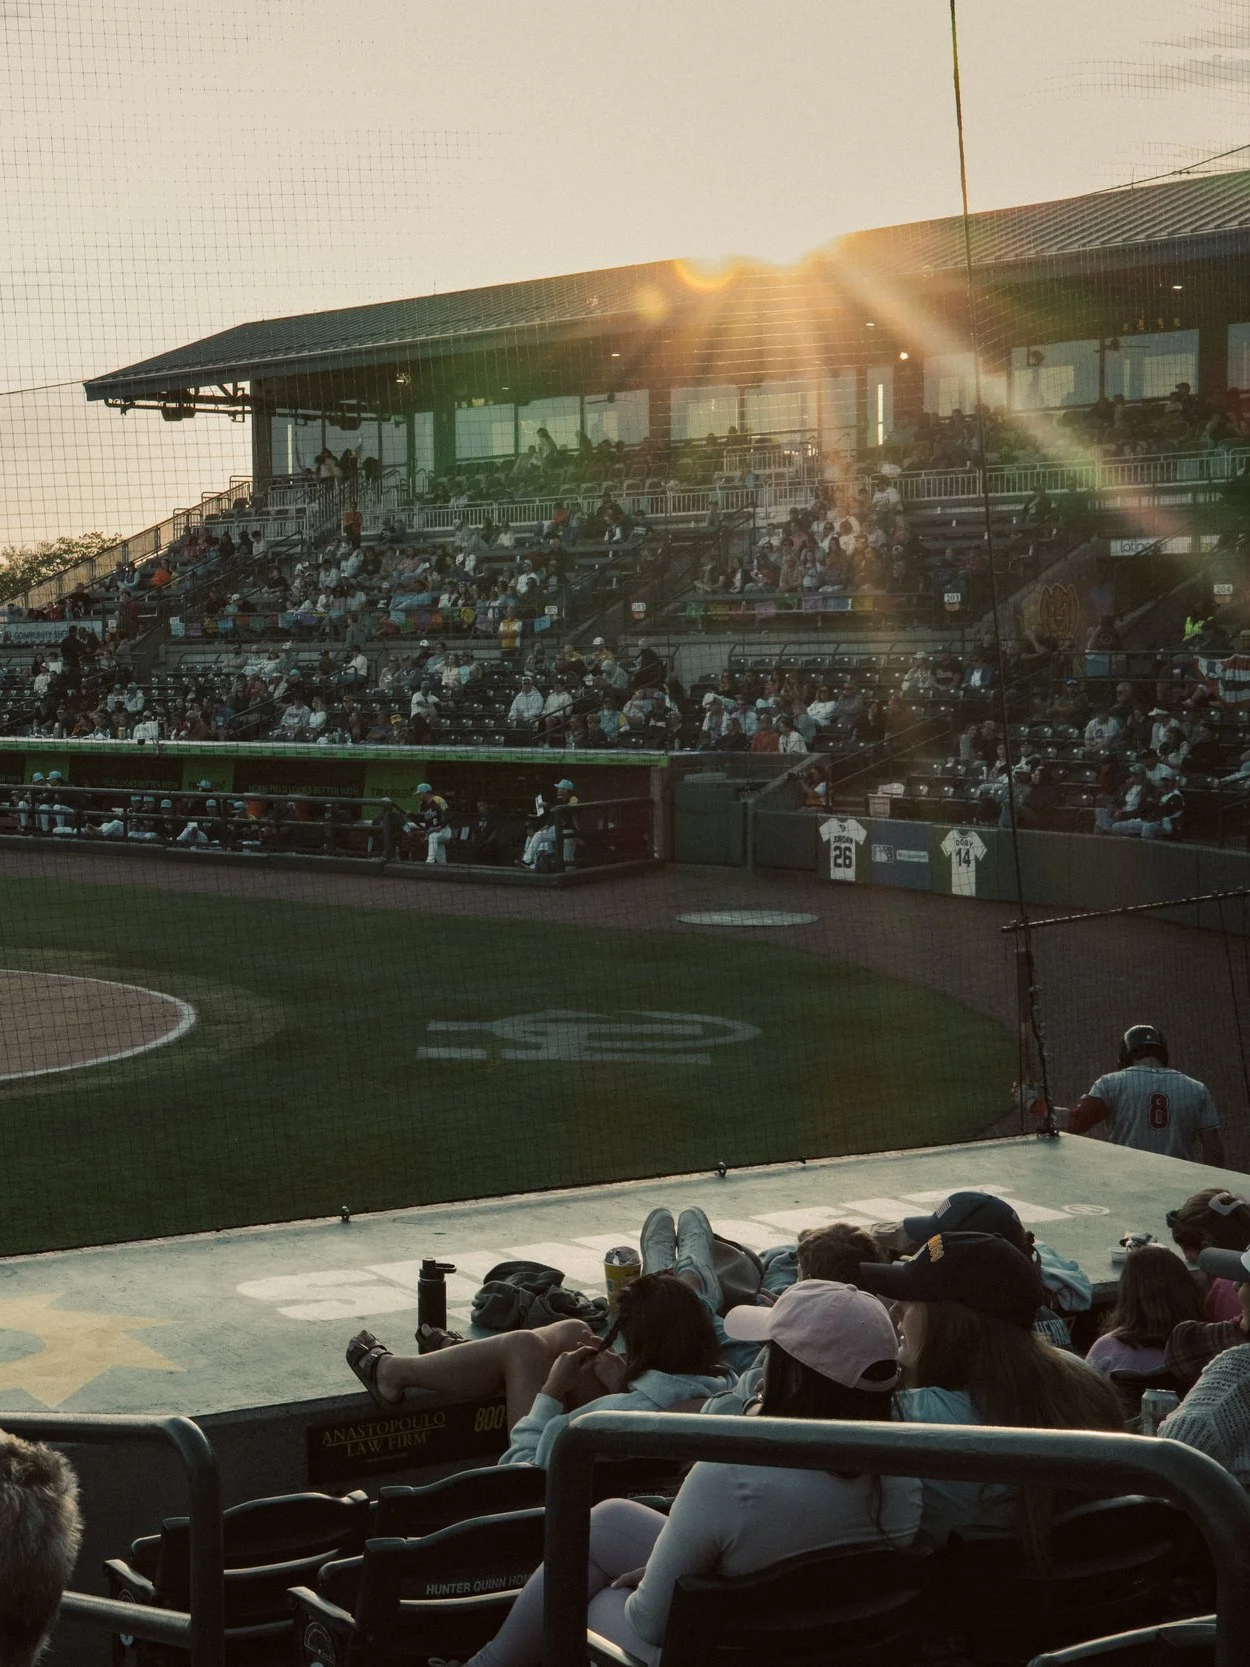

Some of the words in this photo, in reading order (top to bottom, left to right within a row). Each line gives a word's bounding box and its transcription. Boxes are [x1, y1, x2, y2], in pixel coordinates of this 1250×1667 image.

[833, 835, 854, 844] JORDAN
[955, 838, 974, 848] DOBY
[833, 845, 853, 869] 26
[956, 847, 972, 868] 14
[1148, 1091, 1171, 1132] 8
[321, 1410, 447, 1445] ANASTOPOULO
[346, 1438, 384, 1457] LAW
[425, 1581, 471, 1595] HUNTER
[473, 1577, 507, 1593] QUINN
